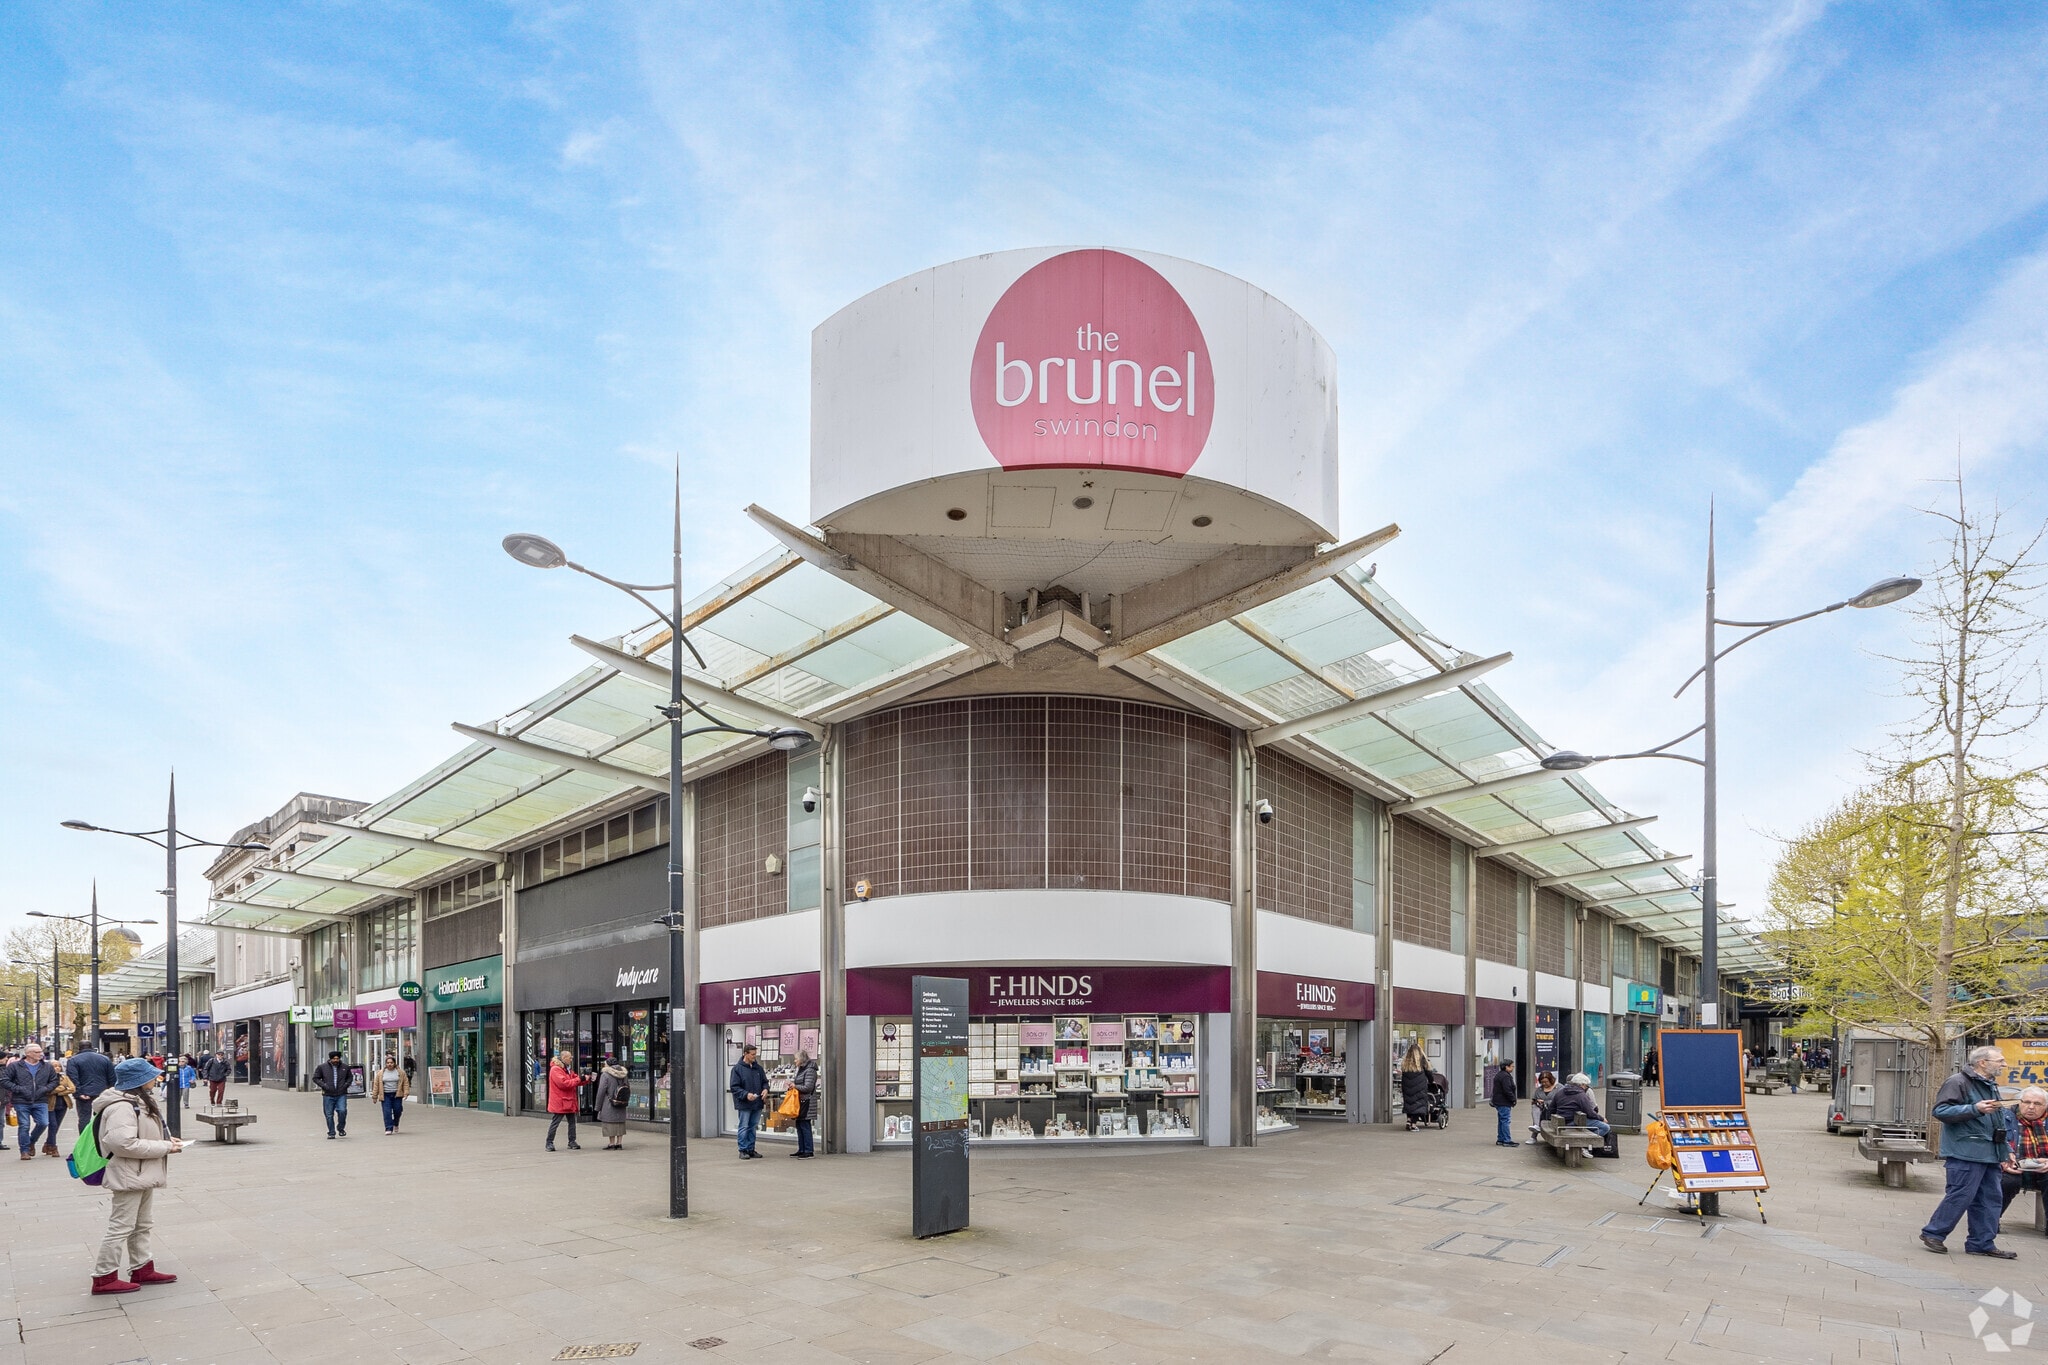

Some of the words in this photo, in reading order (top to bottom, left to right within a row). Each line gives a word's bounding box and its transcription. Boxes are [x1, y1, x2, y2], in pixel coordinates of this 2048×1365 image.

[1076, 322, 1119, 352] the
[995, 341, 1195, 417] brunel
[1034, 413, 1158, 442] swindon
[615, 965, 659, 994] bodycare
[989, 975, 1093, 996] F.HINDS
[1296, 982, 1336, 1004] F.HINDS
[733, 983, 787, 1006] F.HINDS
[998, 999, 1040, 1007] JEWELLERS
[1041, 998, 1065, 1006] SINCE
[1067, 998, 1085, 1006] 1856
[524, 1021, 534, 1094] bodycare
